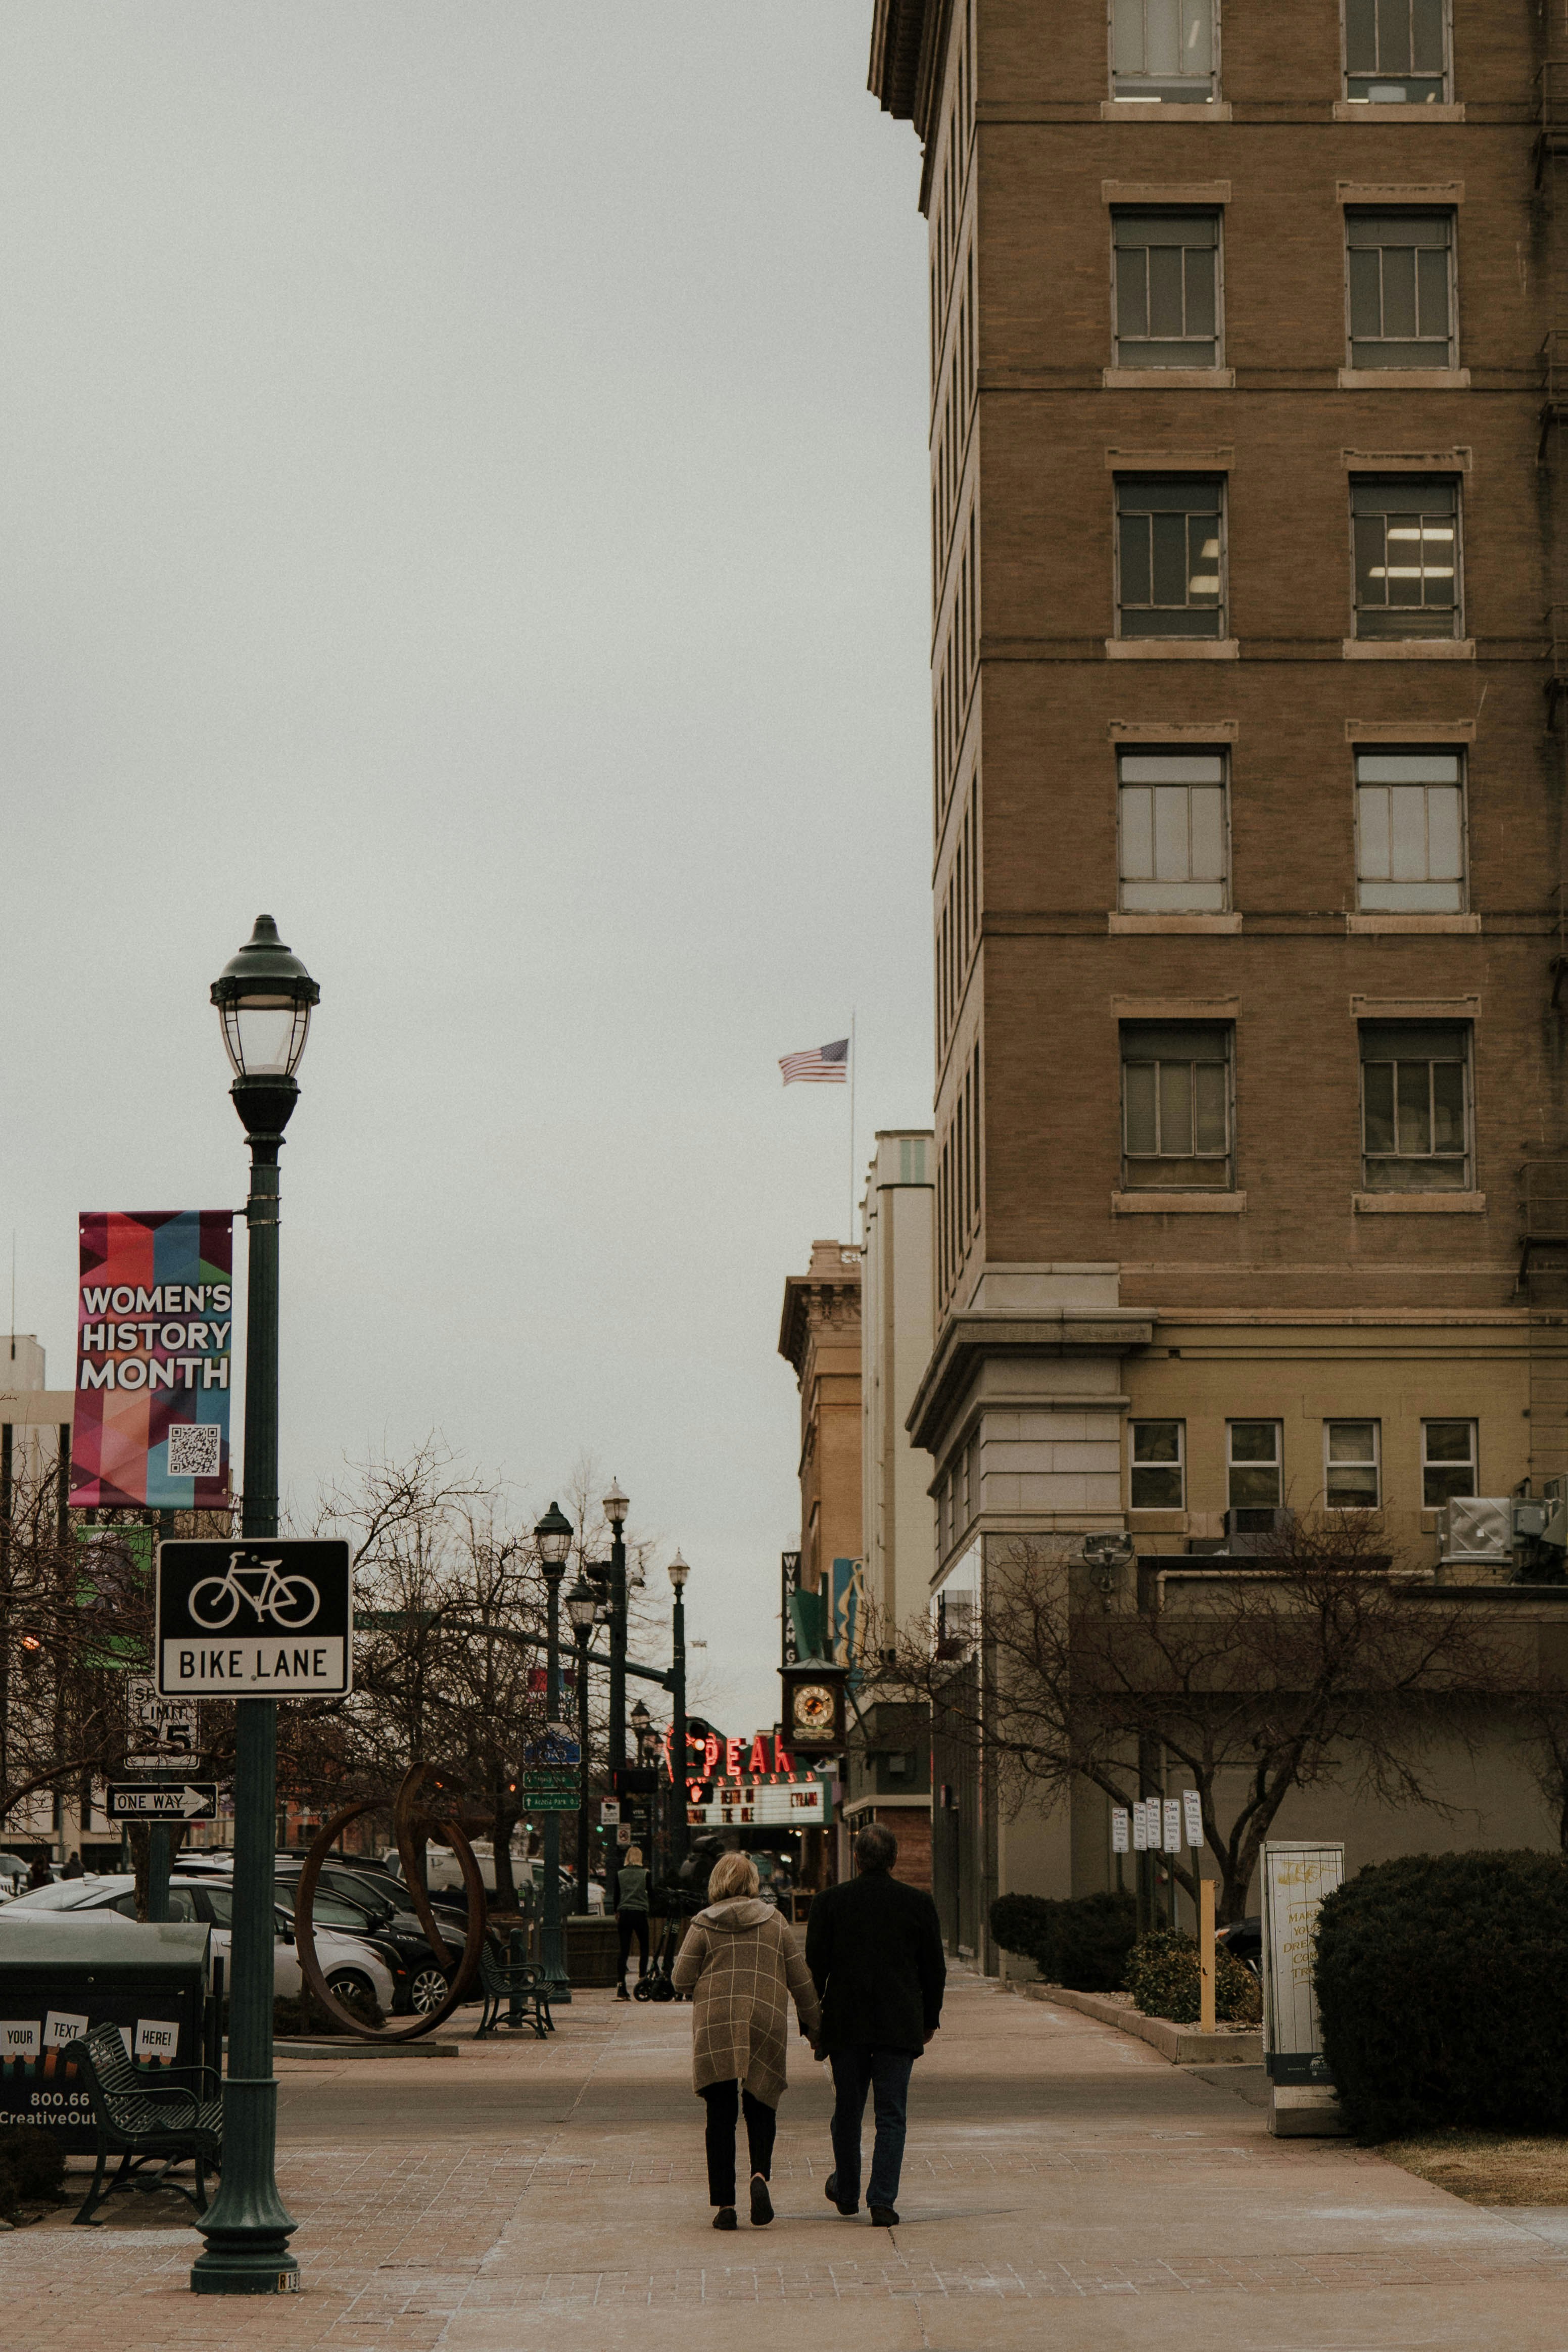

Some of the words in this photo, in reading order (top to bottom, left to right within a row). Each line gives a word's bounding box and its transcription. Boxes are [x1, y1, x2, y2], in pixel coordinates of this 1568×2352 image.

[83, 1284, 231, 1314] WOMEN'S
[83, 1322, 231, 1350] HISTORY
[80, 1357, 228, 1389] MONTH
[180, 1650, 243, 1678] BIKE
[257, 1649, 327, 1678] LANE
[139, 1706, 186, 1719] LIMIT
[703, 1733, 793, 1777] PEAK
[118, 1796, 146, 1809] ONE
[153, 1795, 183, 1808] WAY
[1283, 1938, 1317, 1953] DREA
[1293, 1952, 1318, 1964] COM
[7, 2030, 33, 2045] YOUR
[54, 2022, 79, 2039] TEXT
[142, 2030, 172, 2046] HERE!
[30, 2092, 90, 2106] 800.66
[0, 2110, 98, 2125] CreativeOut
